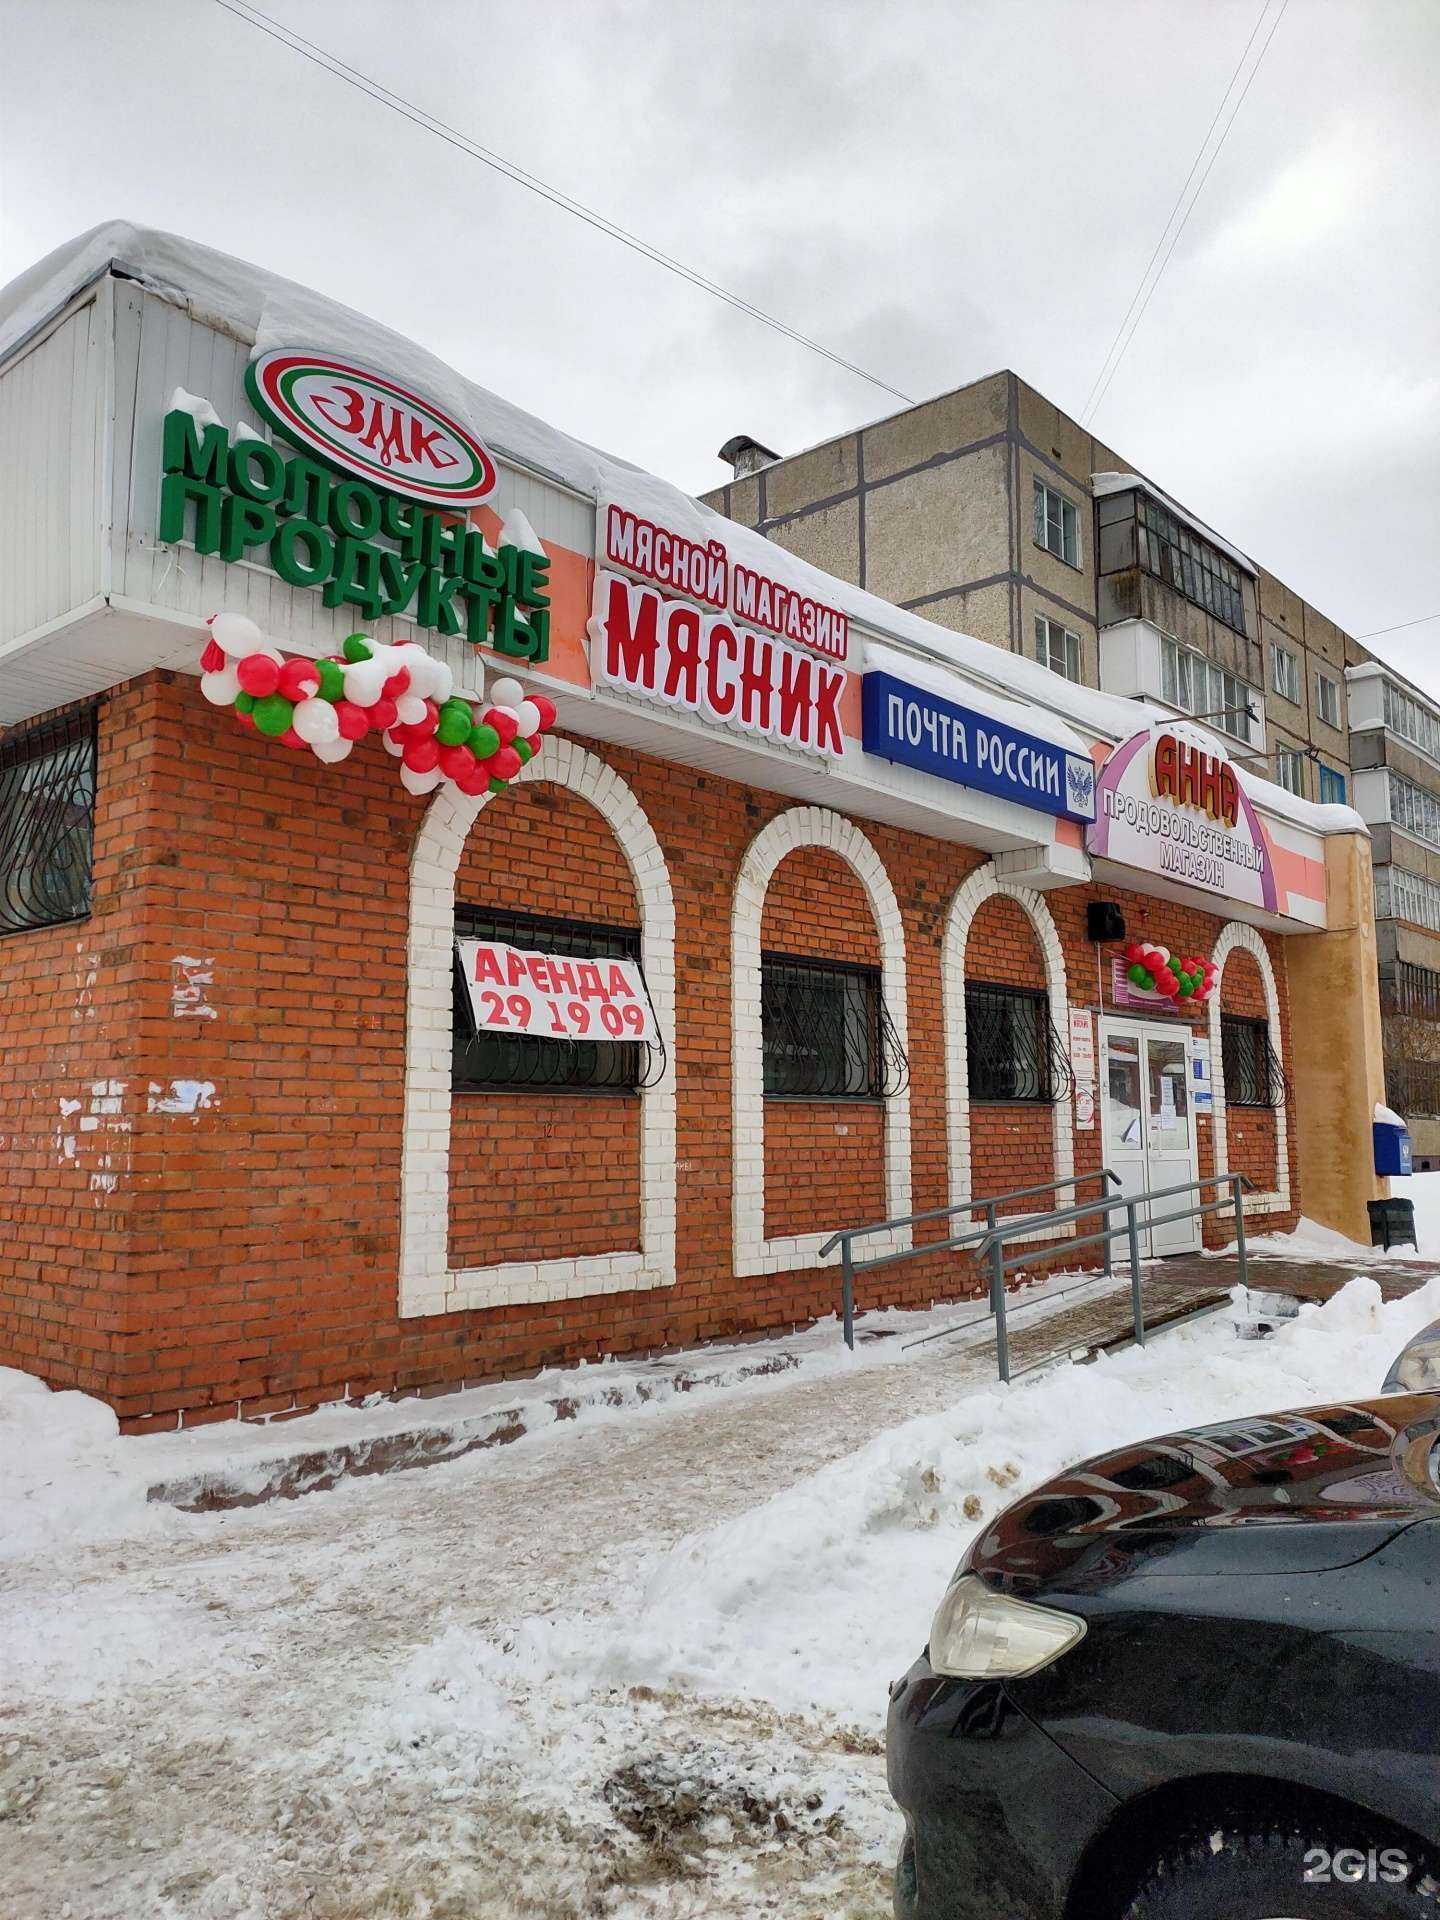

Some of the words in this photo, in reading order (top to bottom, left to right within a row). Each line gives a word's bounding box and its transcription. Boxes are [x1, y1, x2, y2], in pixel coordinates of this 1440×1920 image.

[309, 385, 459, 469] ЗМК
[163, 409, 551, 609] МОЛОЧНЫЕ
[159, 472, 551, 663] ПРОДУКТЫ
[608, 504, 728, 609] МЯСНОЙ
[733, 564, 848, 661] МАГАЗИН
[604, 579, 844, 755] МЯСНИК
[888, 693, 968, 764] ПОЧТА
[976, 729, 1060, 797] РОССИИ
[1152, 734, 1240, 828] АННА
[1103, 787, 1265, 874] ПРОДОВОЛЬСТВЕННЫЙ
[1159, 841, 1225, 889] МАГАЗИН
[474, 948, 636, 1003] АРЕНДА
[480, 991, 532, 1028] 29
[547, 1000, 591, 1033] 19
[600, 1003, 645, 1036] 09
